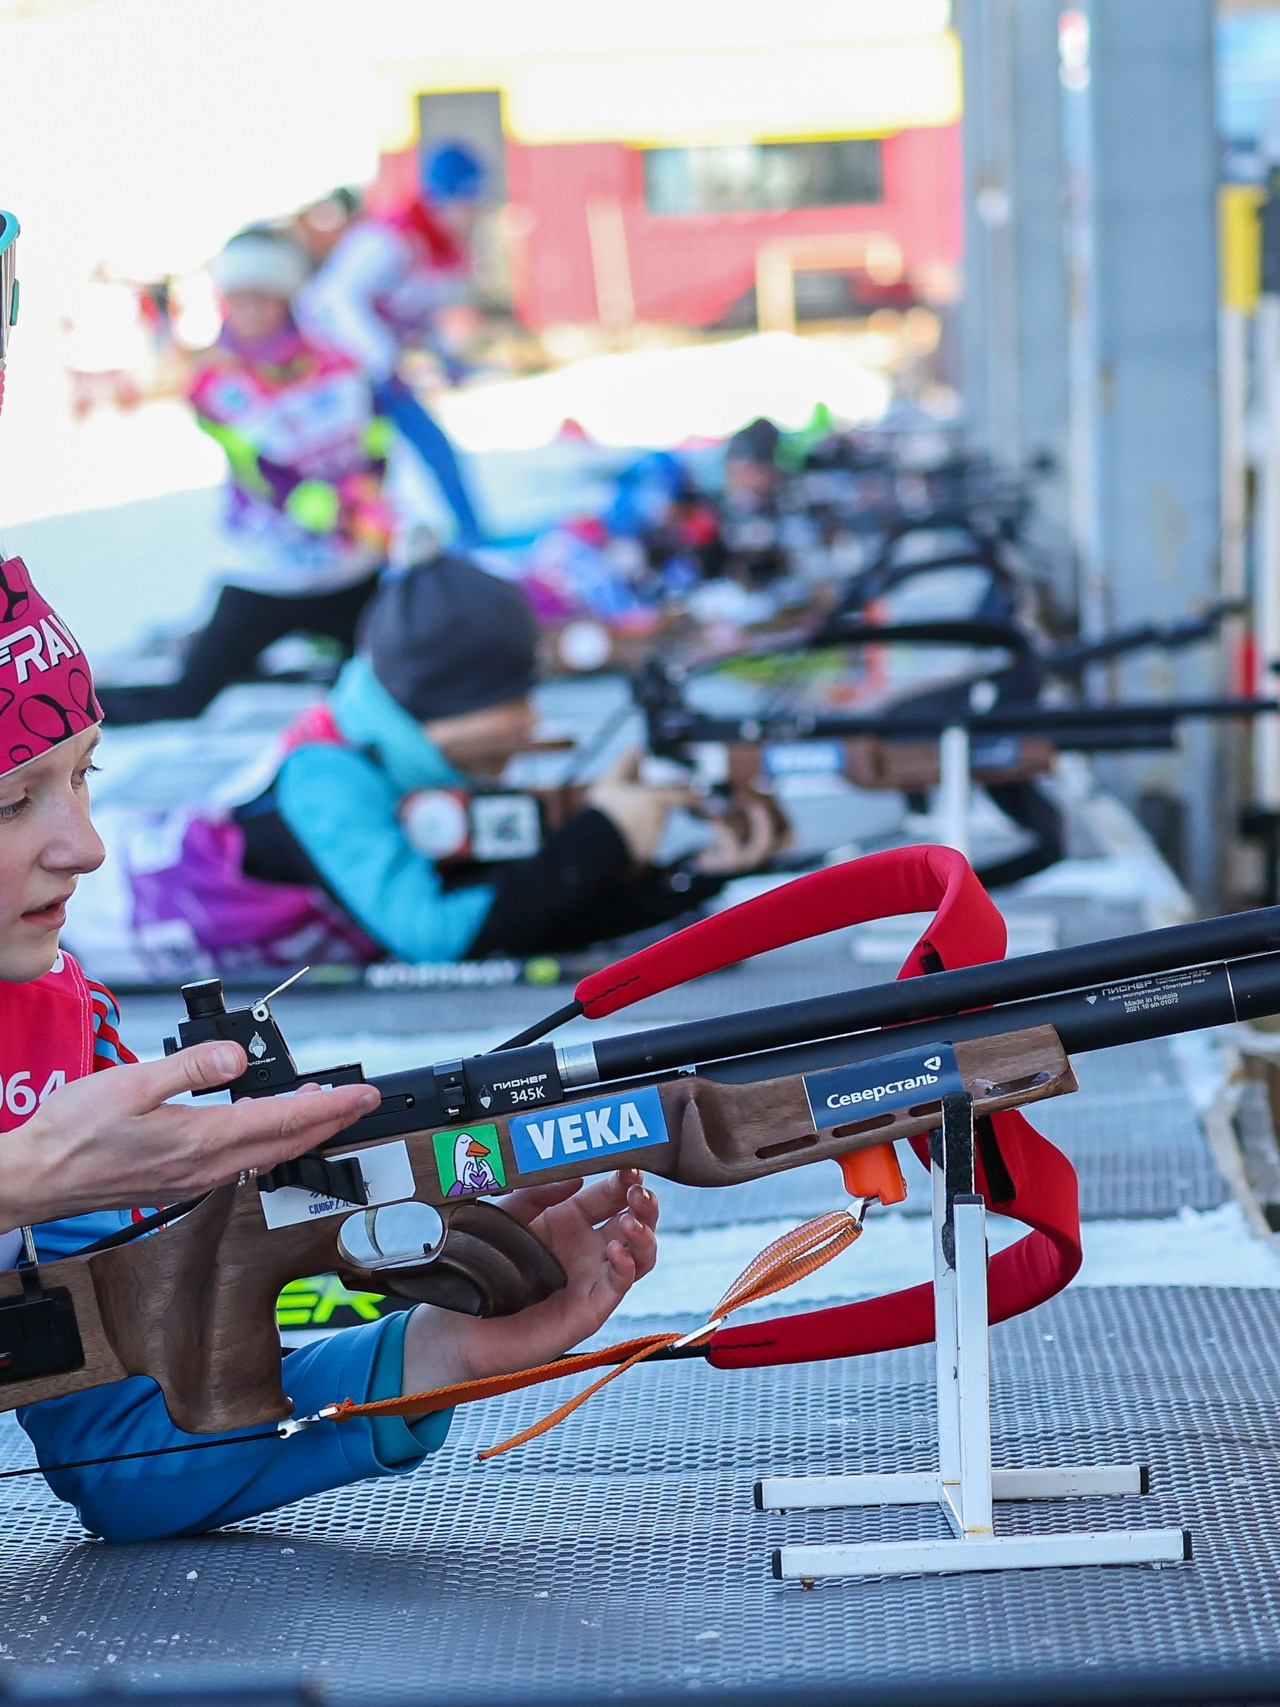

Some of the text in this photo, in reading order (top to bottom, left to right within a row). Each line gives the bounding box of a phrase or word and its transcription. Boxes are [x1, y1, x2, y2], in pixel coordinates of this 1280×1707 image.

[1101, 979, 1153, 996] ПИОНЕР
[1124, 998, 1144, 1008] Made
[1153, 992, 1178, 1002] Russia
[1125, 1003, 1149, 1013] 2021.10
[493, 1073, 548, 1091] ПИОНЕР
[826, 1073, 939, 1109] Северсталь
[526, 1101, 649, 1160] VEKA
[308, 1200, 335, 1216] СДЮБР
